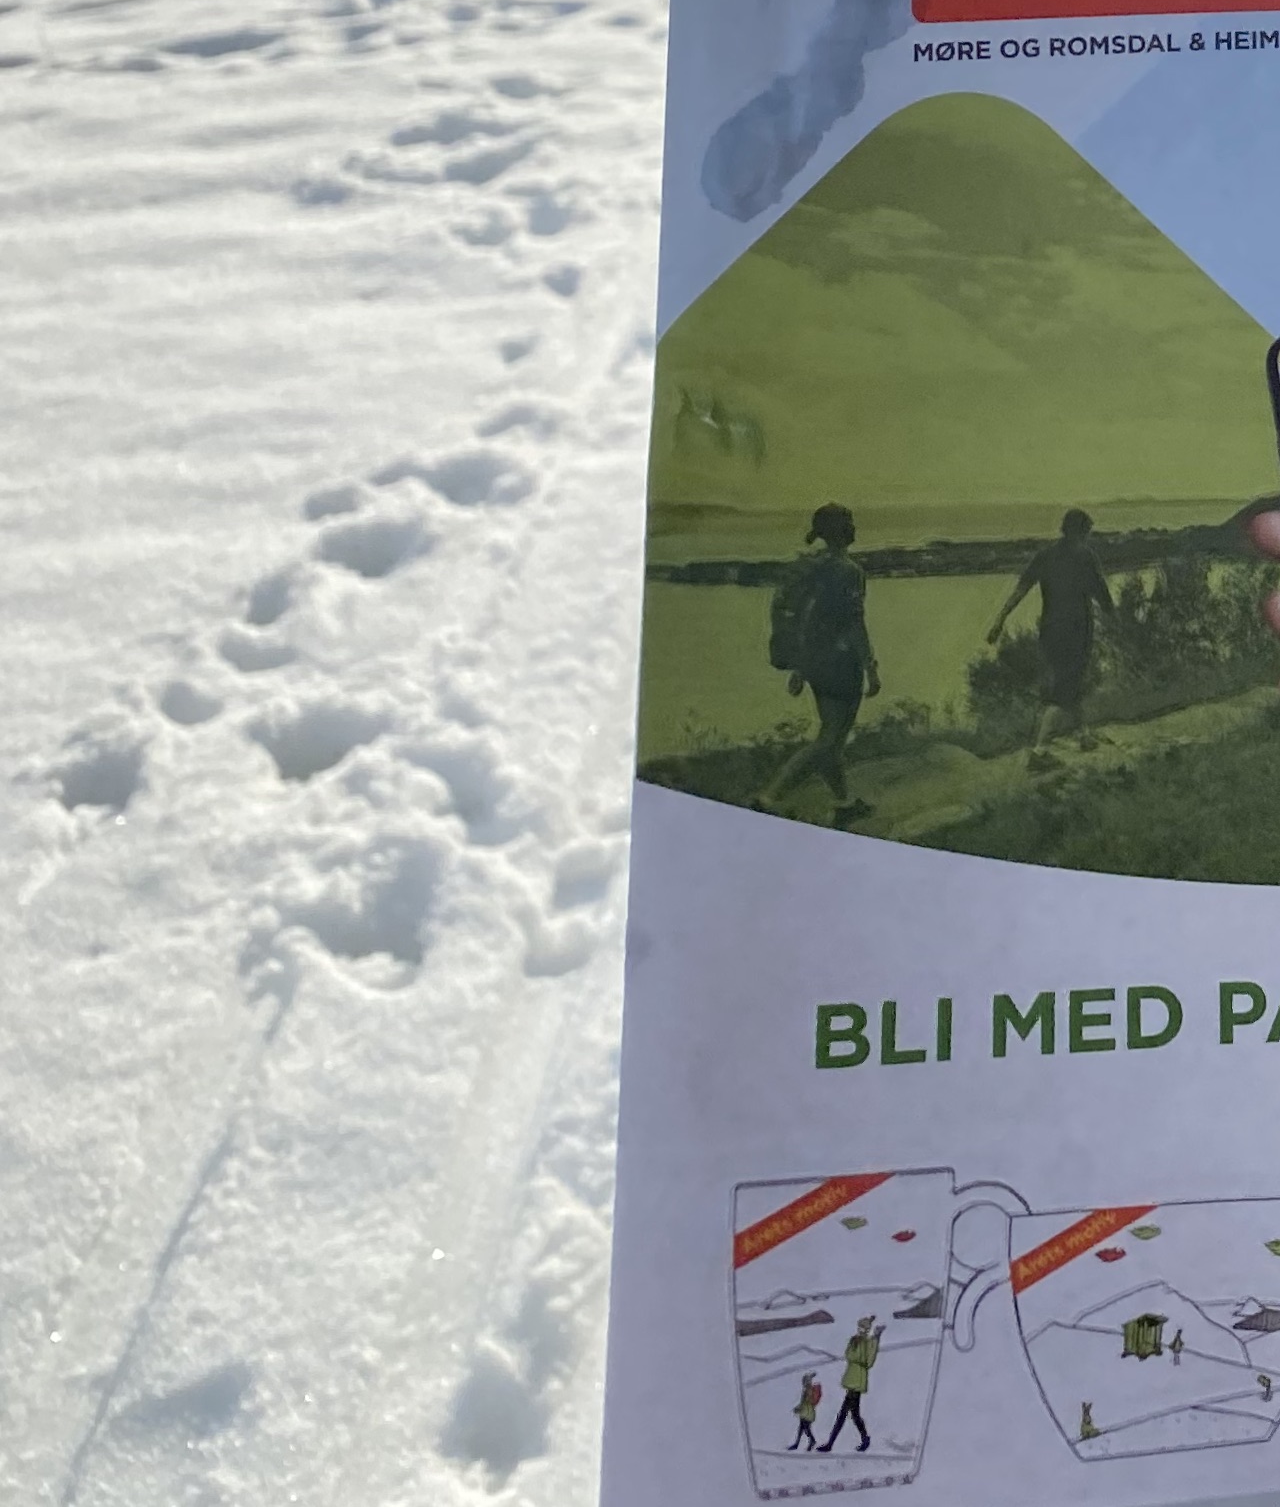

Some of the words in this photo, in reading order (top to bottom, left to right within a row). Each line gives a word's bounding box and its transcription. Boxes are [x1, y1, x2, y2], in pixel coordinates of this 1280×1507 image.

[913, 40, 992, 62] MØRE
[999, 38, 1040, 59] OG
[1049, 33, 1181, 57] ROMSDAL
[1189, 32, 1206, 52] &
[1215, 30, 1280, 51] HEIM
[815, 997, 953, 1070] BLI
[992, 985, 1184, 1059] MED
